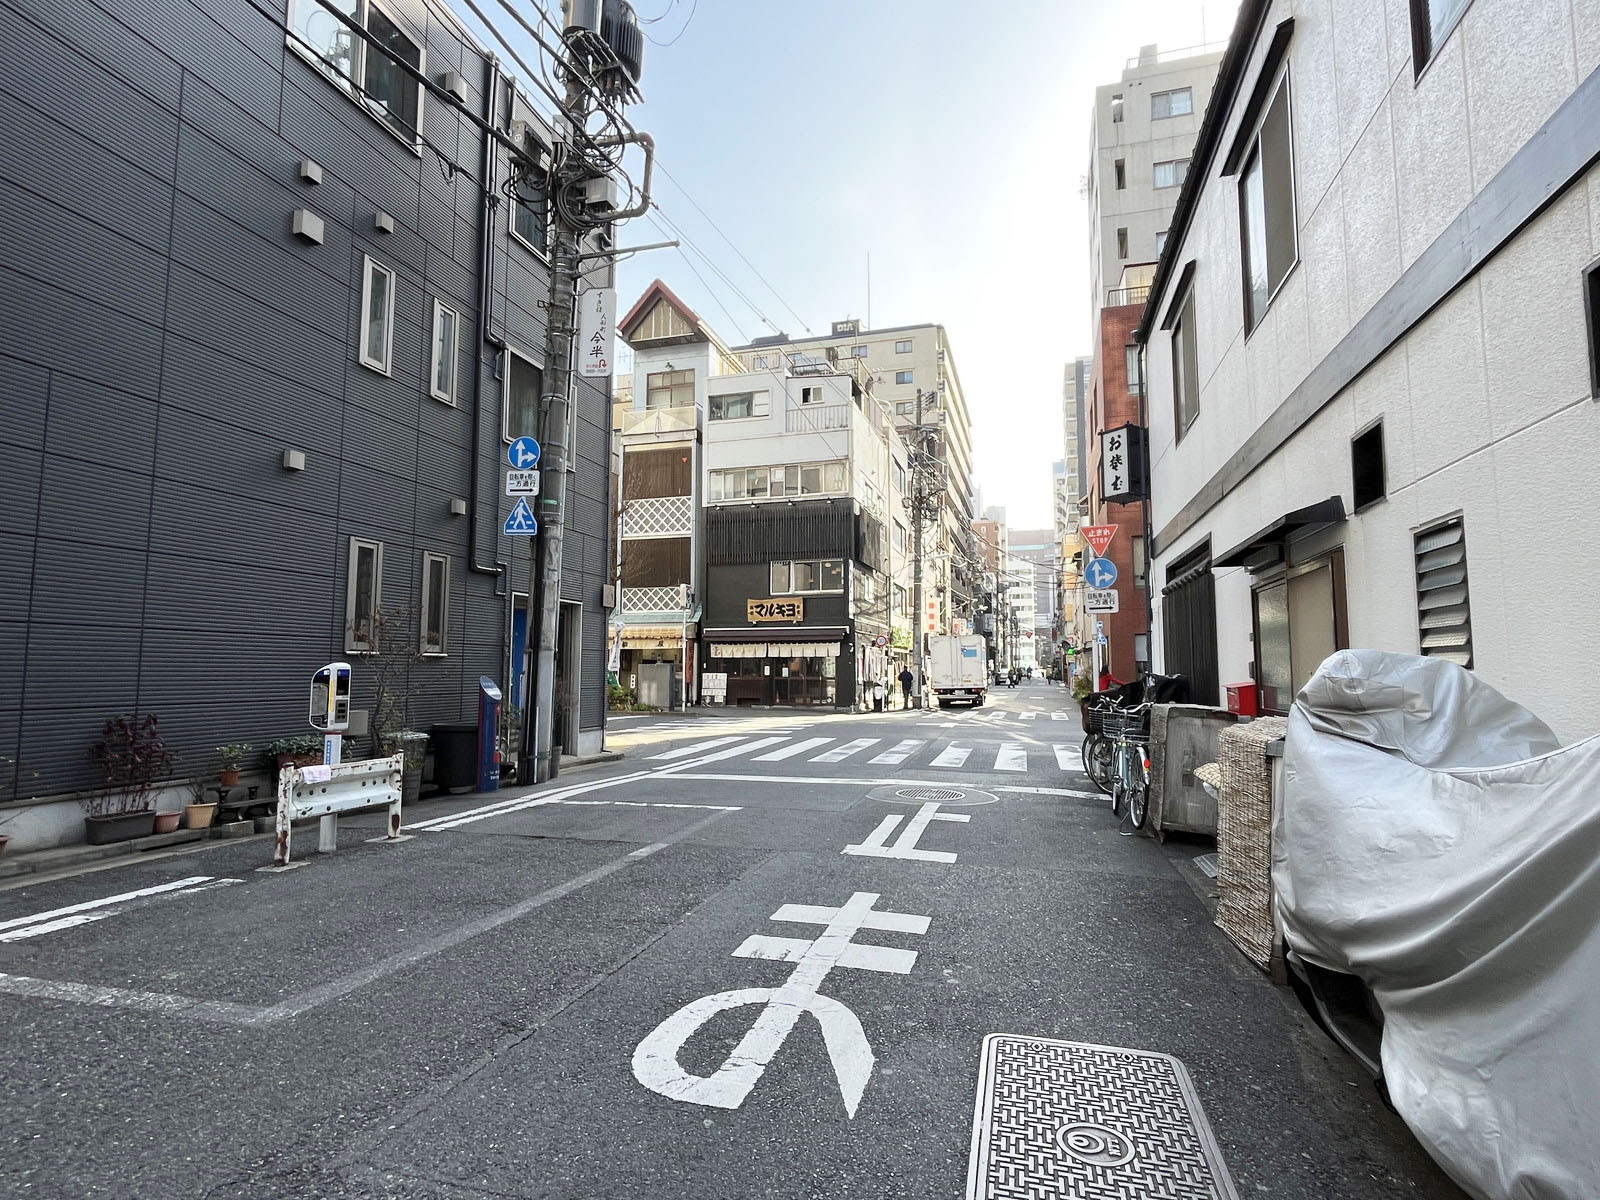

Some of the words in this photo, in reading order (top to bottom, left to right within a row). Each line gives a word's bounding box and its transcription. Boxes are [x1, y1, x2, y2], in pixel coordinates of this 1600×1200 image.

[589, 331, 606, 358] 今半
[509, 480, 536, 488] 一方通行
[1088, 528, 1111, 537] 止まれ
[1092, 537, 1108, 545] STOP
[1087, 592, 1115, 600] 自転車を除く
[754, 603, 796, 618] マルキヨ
